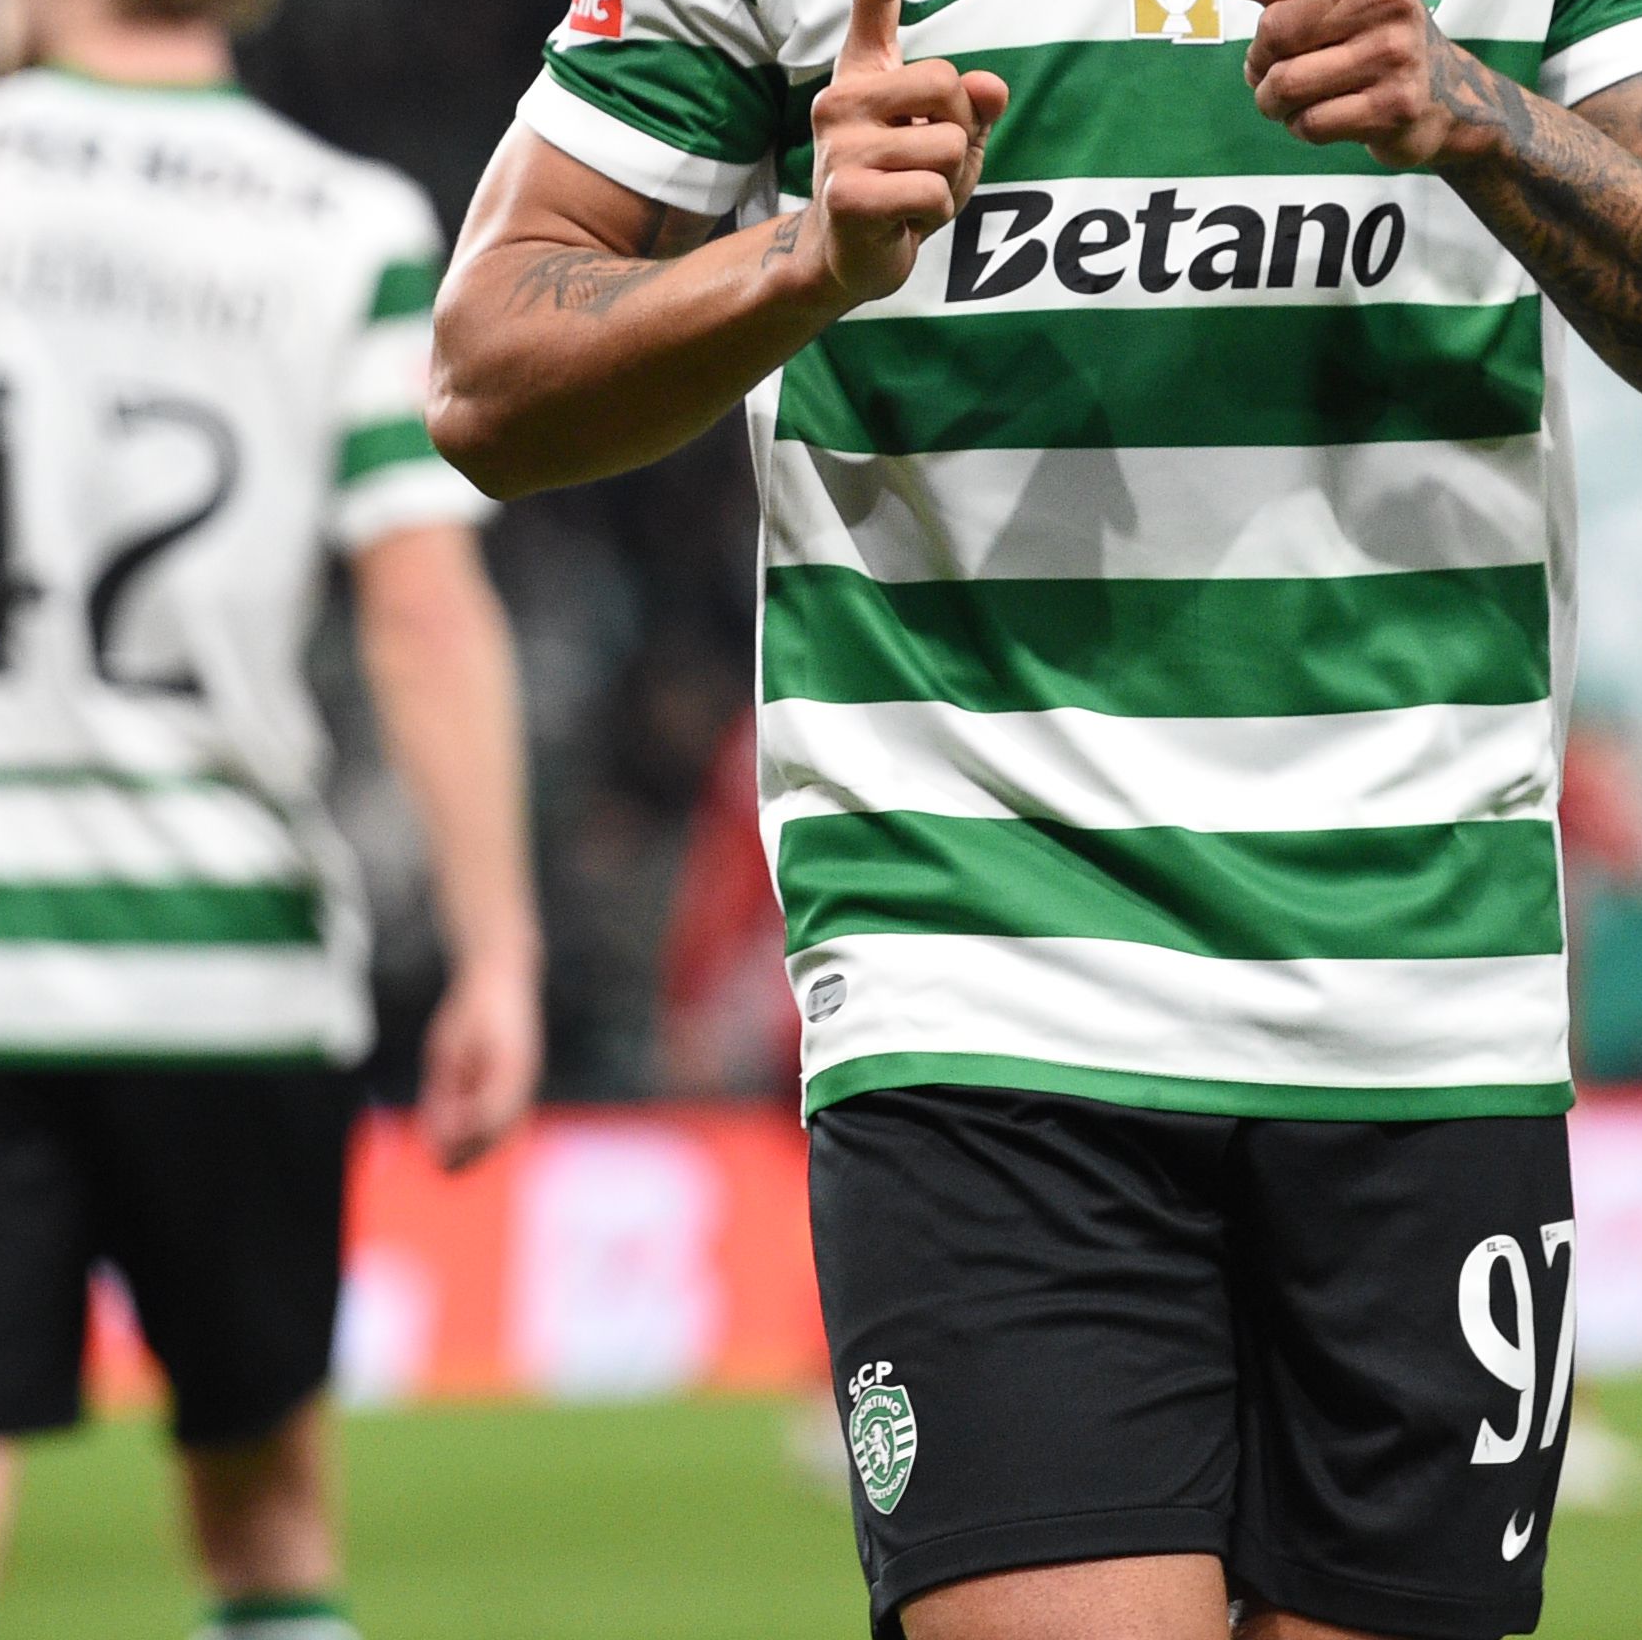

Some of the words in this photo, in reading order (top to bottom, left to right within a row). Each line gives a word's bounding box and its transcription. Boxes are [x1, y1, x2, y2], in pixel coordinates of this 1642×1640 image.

[944, 188, 1405, 303] Betano
[1458, 1218, 1576, 1465] 97
[848, 1361, 893, 1403] SCP
[853, 1395, 902, 1437] SPORTING
